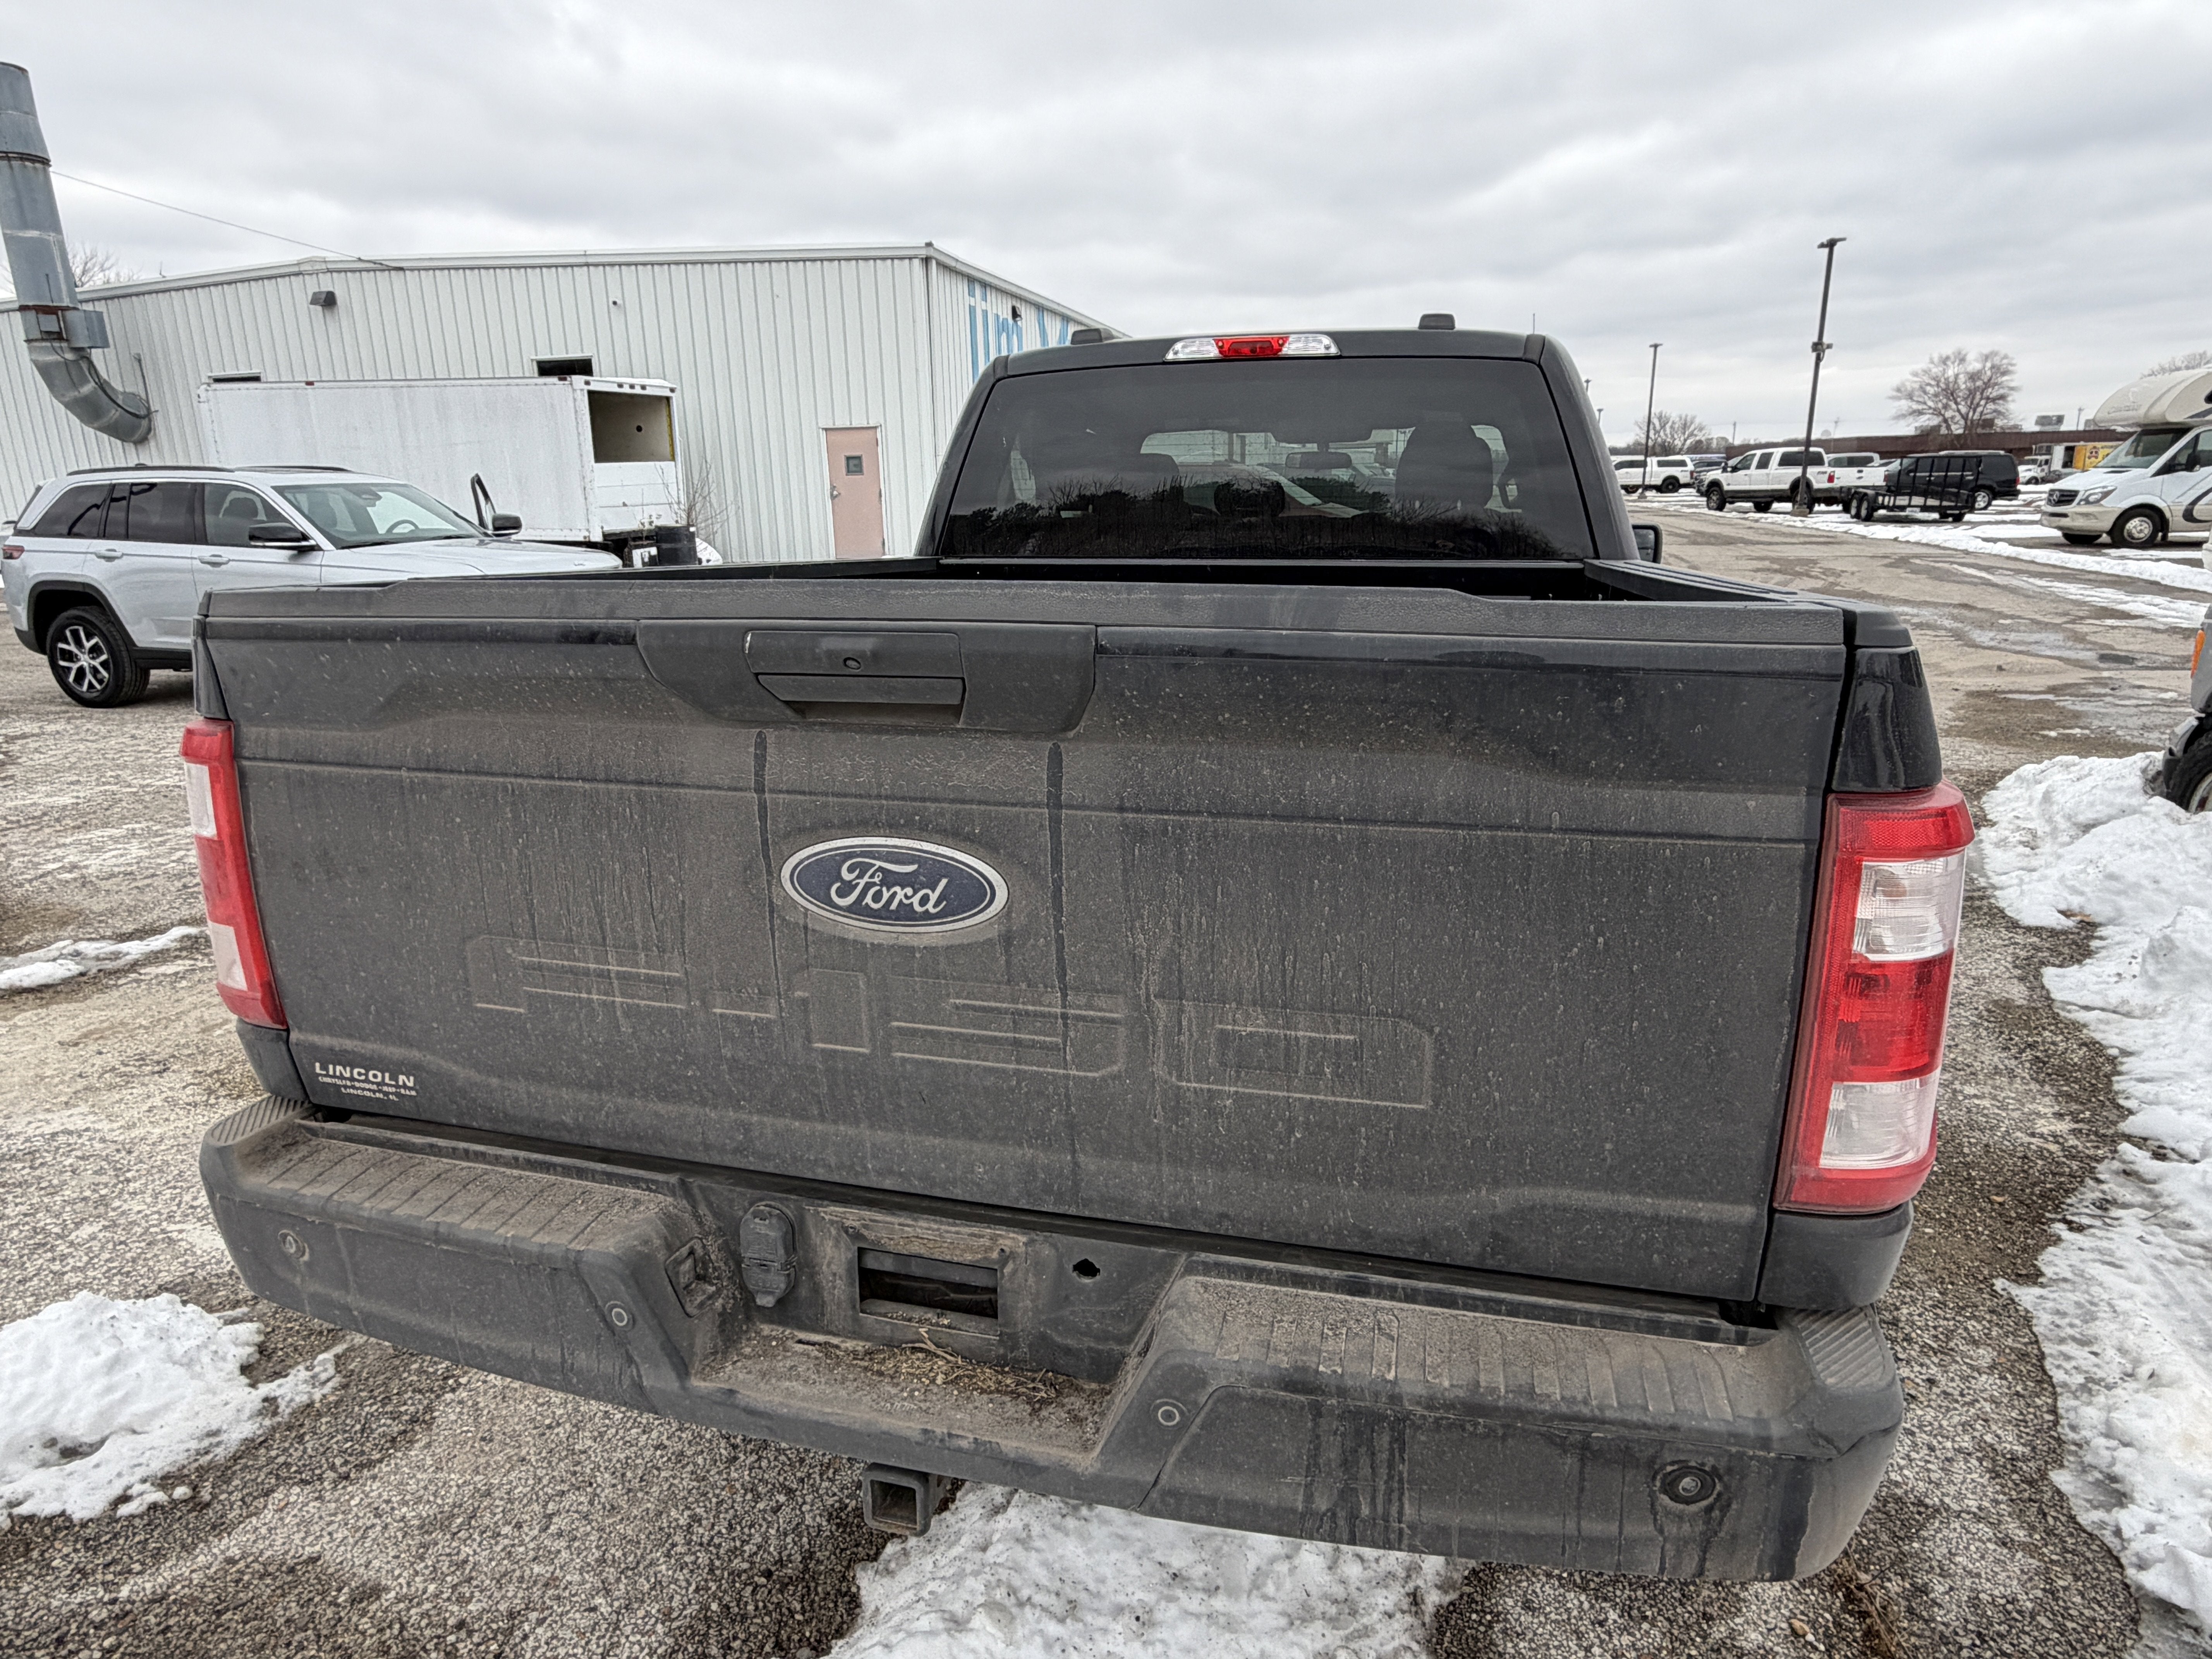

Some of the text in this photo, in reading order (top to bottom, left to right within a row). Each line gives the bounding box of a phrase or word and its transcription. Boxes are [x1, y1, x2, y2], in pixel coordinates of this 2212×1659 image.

[830, 857, 949, 913] Ford
[468, 934, 1434, 1110] F-150
[315, 1062, 414, 1087] LINCOLN
